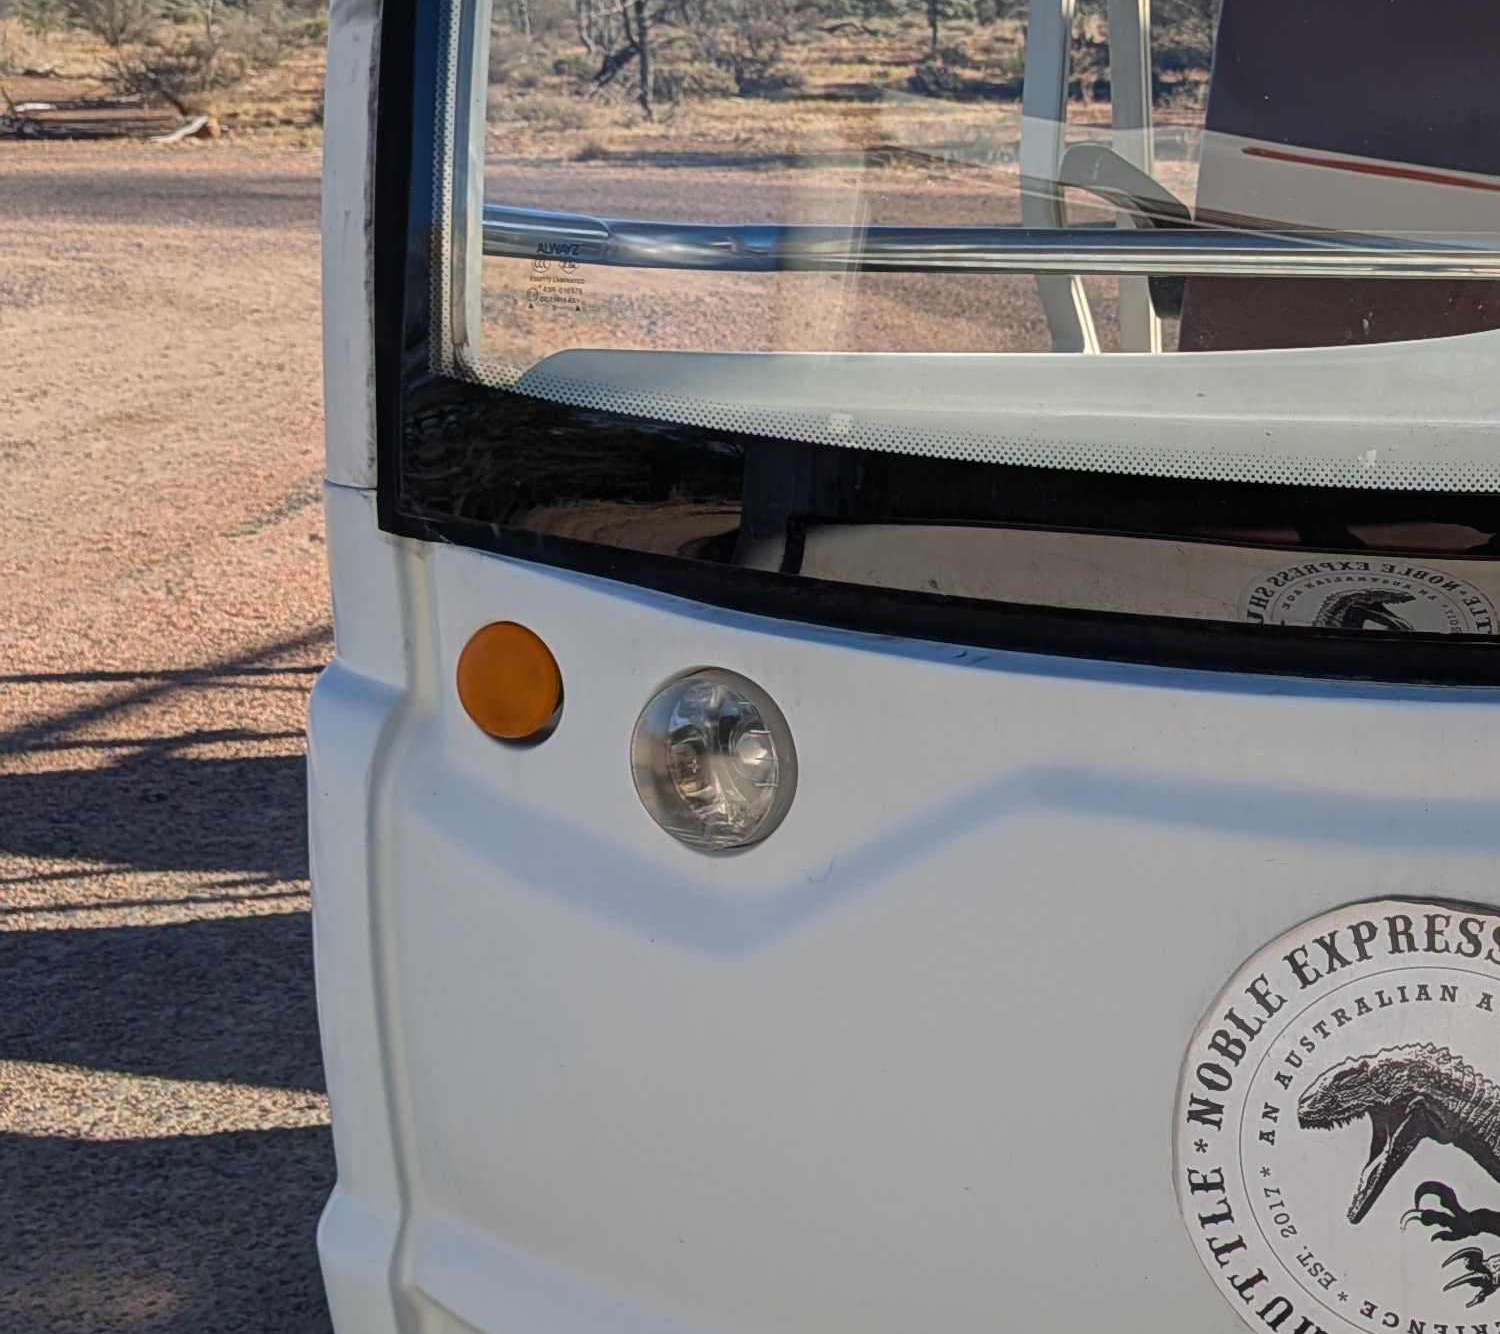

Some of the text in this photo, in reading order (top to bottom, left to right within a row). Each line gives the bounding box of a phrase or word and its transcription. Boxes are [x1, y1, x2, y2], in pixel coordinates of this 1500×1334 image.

[537, 243, 580, 255] ALWAYZ
[1187, 973, 1287, 1132] NOBLE
[1258, 1102, 1281, 1147] AN
[1274, 983, 1459, 1091] AUSTRALIAN
[1263, 1186, 1338, 1291] EST. 2017
